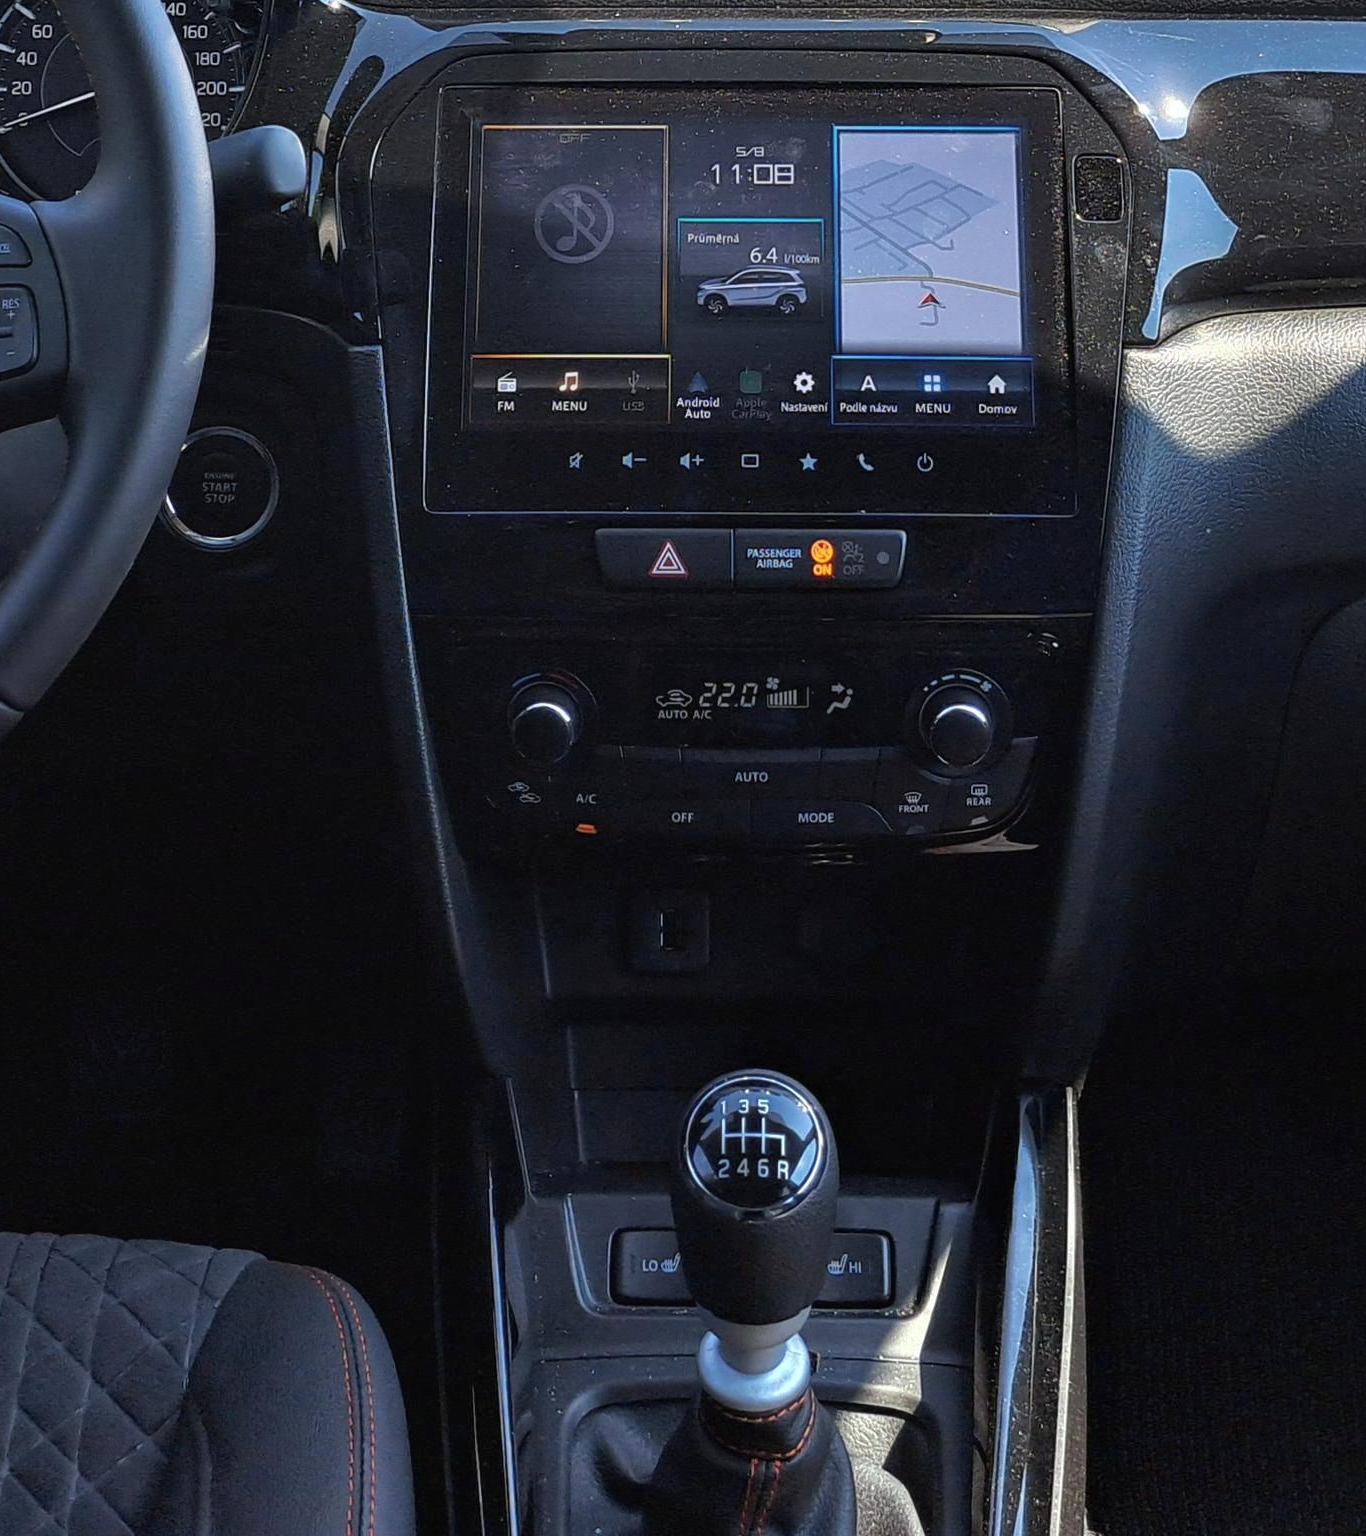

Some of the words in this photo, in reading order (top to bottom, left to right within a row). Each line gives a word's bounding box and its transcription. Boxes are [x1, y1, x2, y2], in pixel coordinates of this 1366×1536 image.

[32, 24, 53, 39] 60
[182, 25, 208, 39] 160
[16, 51, 38, 66] 40
[195, 51, 221, 66] 180
[11, 81, 32, 95] 20
[196, 81, 227, 96] 200
[559, 133, 591, 144] OFF
[710, 163, 795, 185] 11:08
[687, 232, 740, 245] Průměrná
[750, 247, 779, 264] 6.4
[1, 298, 20, 310] RES
[497, 400, 515, 412] FM
[551, 400, 587, 411] MENU
[622, 401, 645, 412] USB
[676, 396, 721, 409] Android
[780, 401, 829, 413] Nastavení
[839, 401, 867, 413] Podle
[869, 401, 898, 413] názvu
[915, 403, 951, 414] MENU
[684, 408, 712, 420] Auto
[978, 403, 1018, 415] Domov
[202, 482, 237, 492] START
[204, 493, 235, 504] STOP
[747, 548, 802, 558] PASSENGER
[756, 558, 793, 569] AIRBAG
[813, 563, 832, 576] ON
[843, 565, 864, 575] OFF
[699, 682, 758, 707] 22.0
[658, 710, 688, 720] AUTO
[692, 710, 712, 720] A/C
[735, 771, 768, 783] AUTO
[575, 793, 597, 804] A/C
[966, 797, 991, 806] REAR
[898, 804, 929, 813] FRONT
[671, 812, 694, 823] OFF
[798, 812, 834, 823] MODE
[721, 1100, 726, 1115] 1
[739, 1099, 749, 1114] 3
[758, 1099, 769, 1114] 5
[718, 1158, 730, 1178] 2
[736, 1158, 749, 1177] 4
[757, 1158, 769, 1178] 6
[777, 1159, 789, 1180] R
[642, 1260, 658, 1272] LO
[849, 1262, 862, 1274] HI
